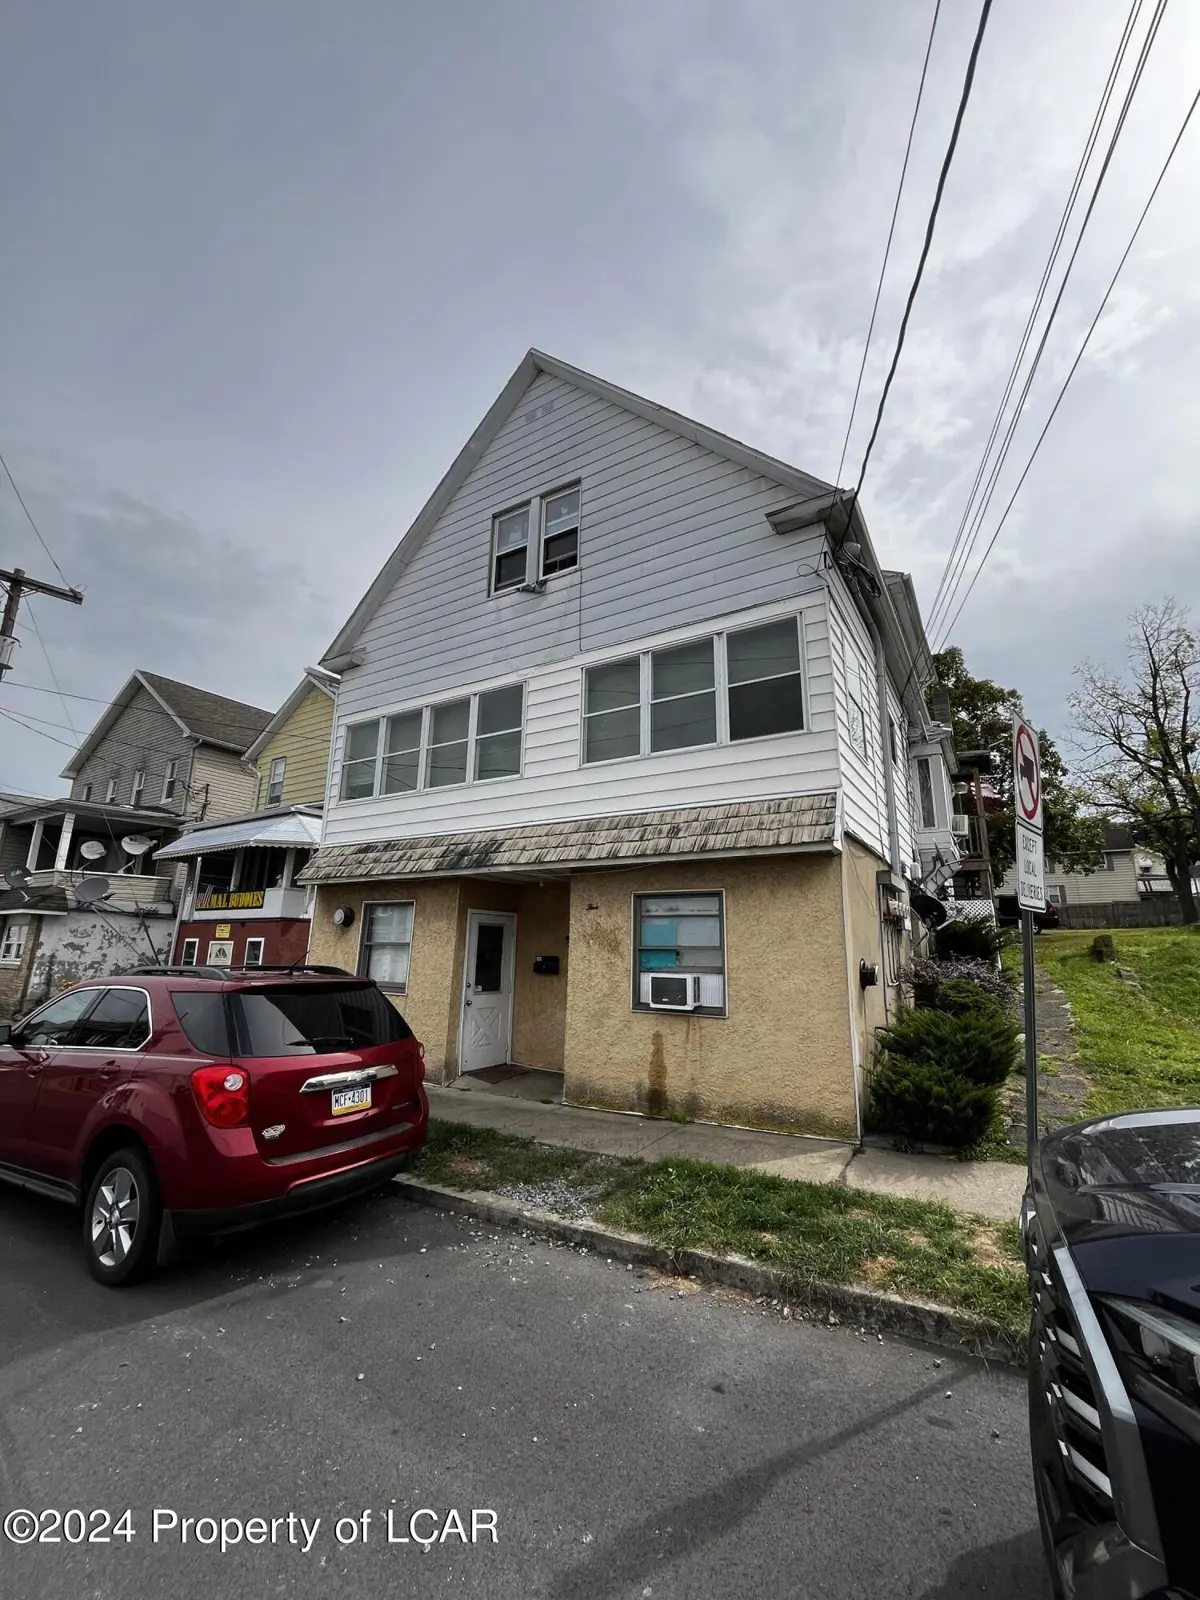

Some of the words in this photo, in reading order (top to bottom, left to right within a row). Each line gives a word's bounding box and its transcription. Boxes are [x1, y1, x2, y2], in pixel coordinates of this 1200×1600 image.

[1022, 834, 1037, 855] EXCEPT
[1023, 858, 1037, 877] LOCAL
[229, 890, 265, 908] BUDDIES
[1020, 881, 1043, 901] DELIVERIES
